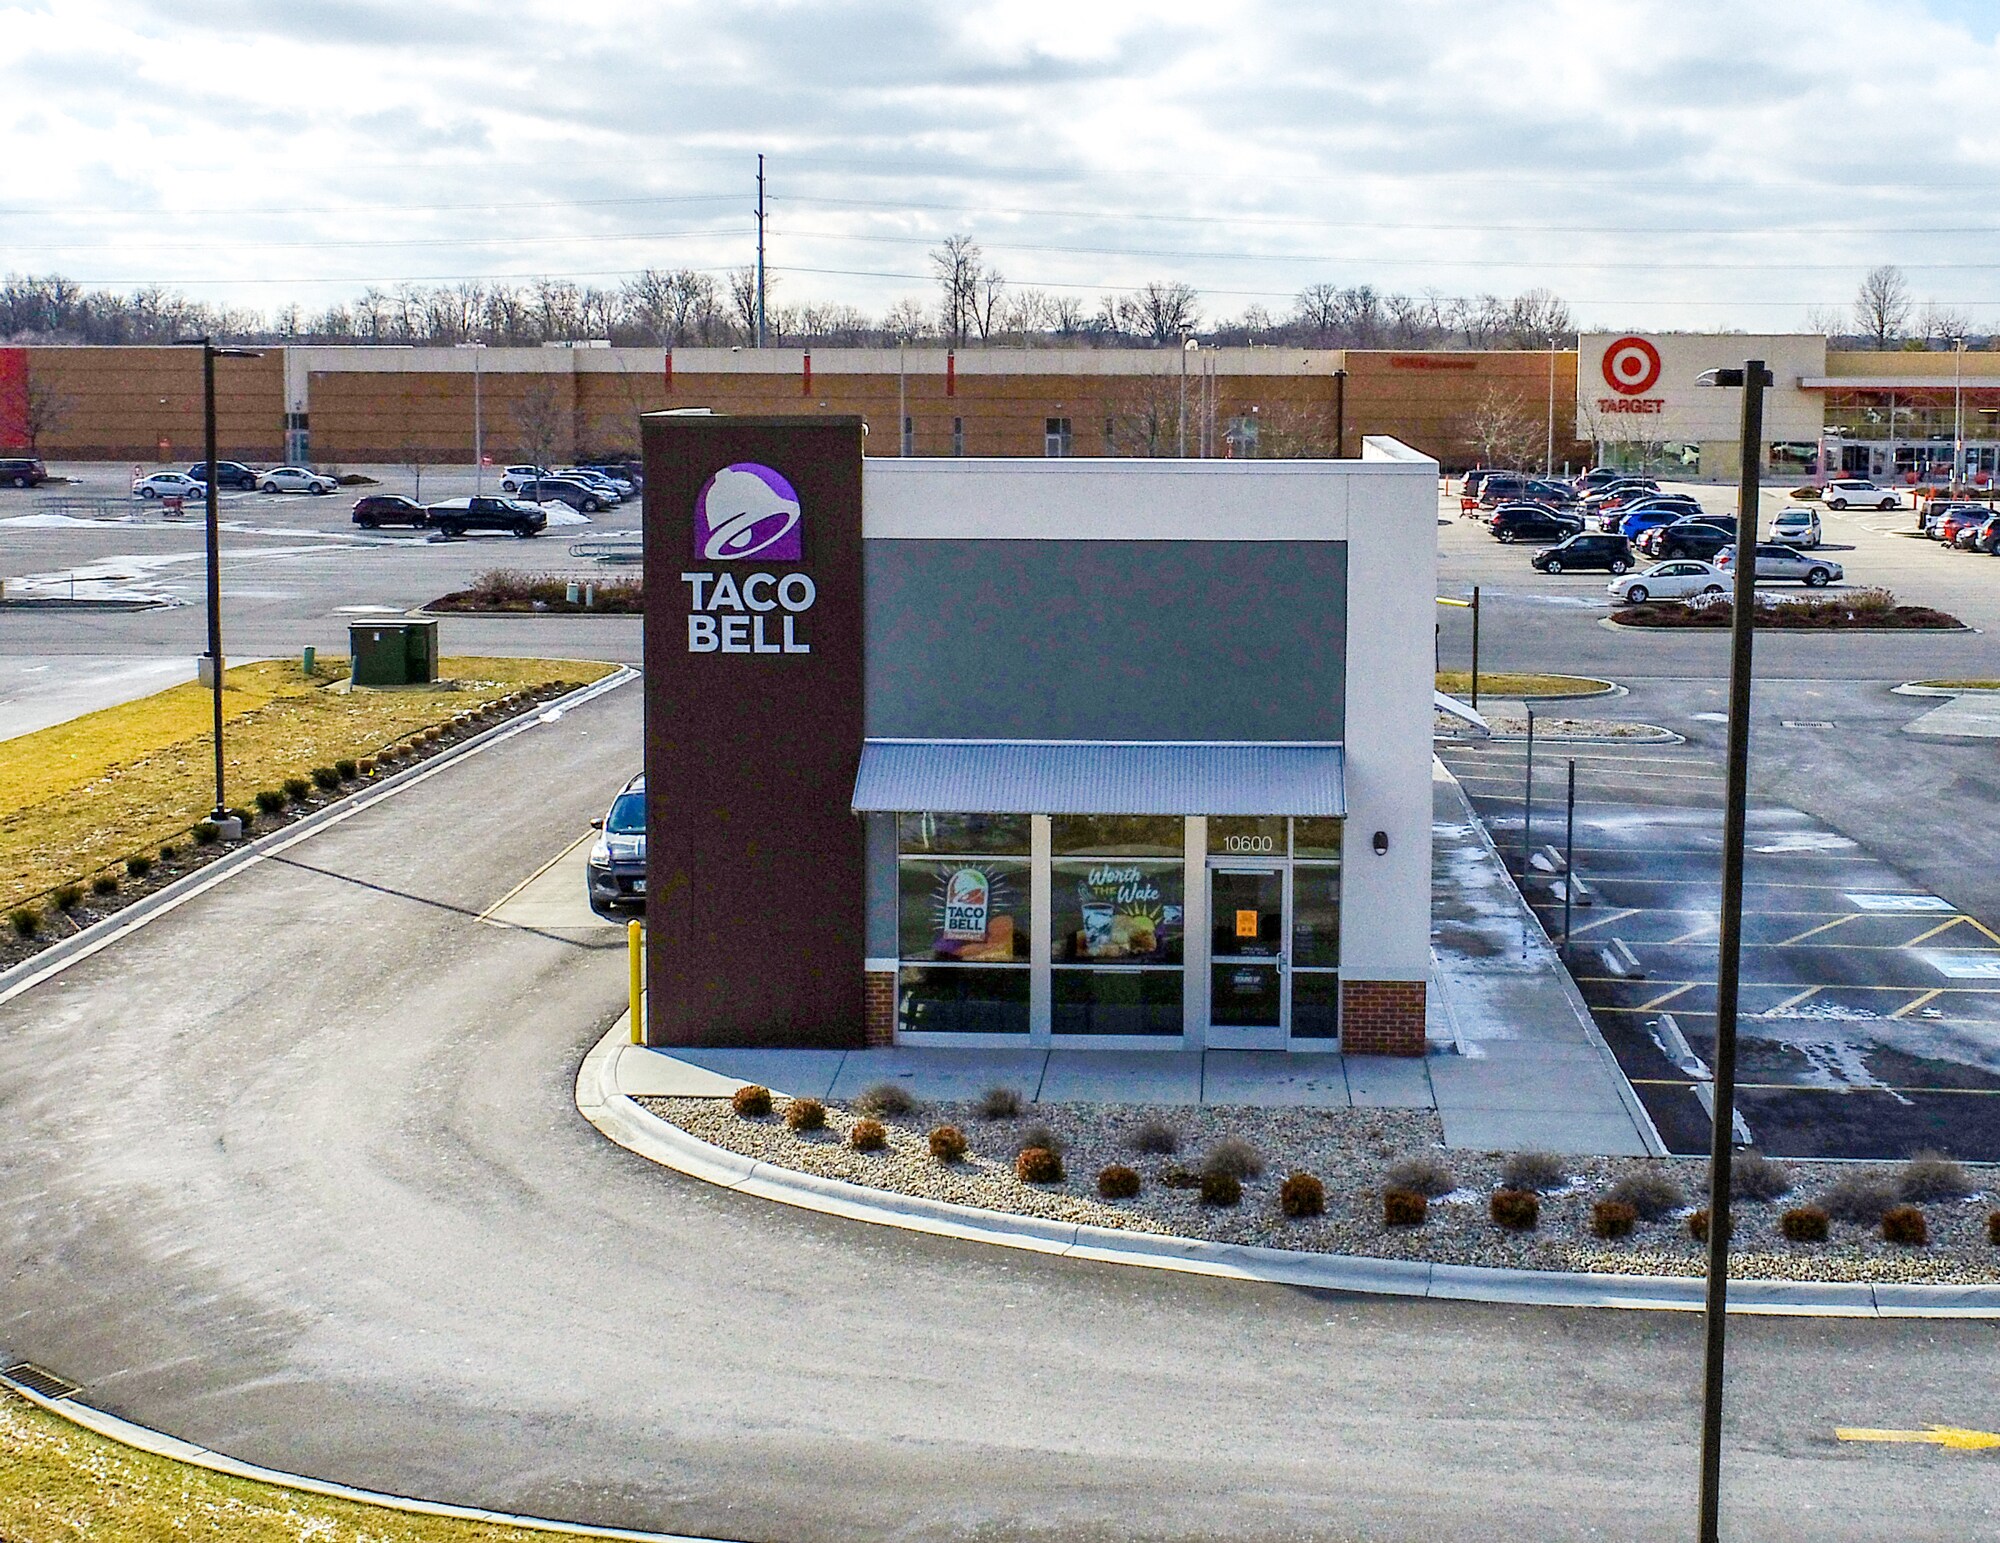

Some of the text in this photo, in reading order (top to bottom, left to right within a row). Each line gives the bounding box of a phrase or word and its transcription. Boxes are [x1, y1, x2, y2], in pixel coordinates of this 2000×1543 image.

[1597, 398, 1665, 414] TARGET
[681, 572, 817, 612] TACO
[688, 614, 811, 653] BELL
[1223, 835, 1273, 852] 10600
[1088, 863, 1141, 886] Worth
[1093, 883, 1160, 903] THE Wake
[948, 906, 985, 919] TACO
[949, 919, 982, 931] BELL
